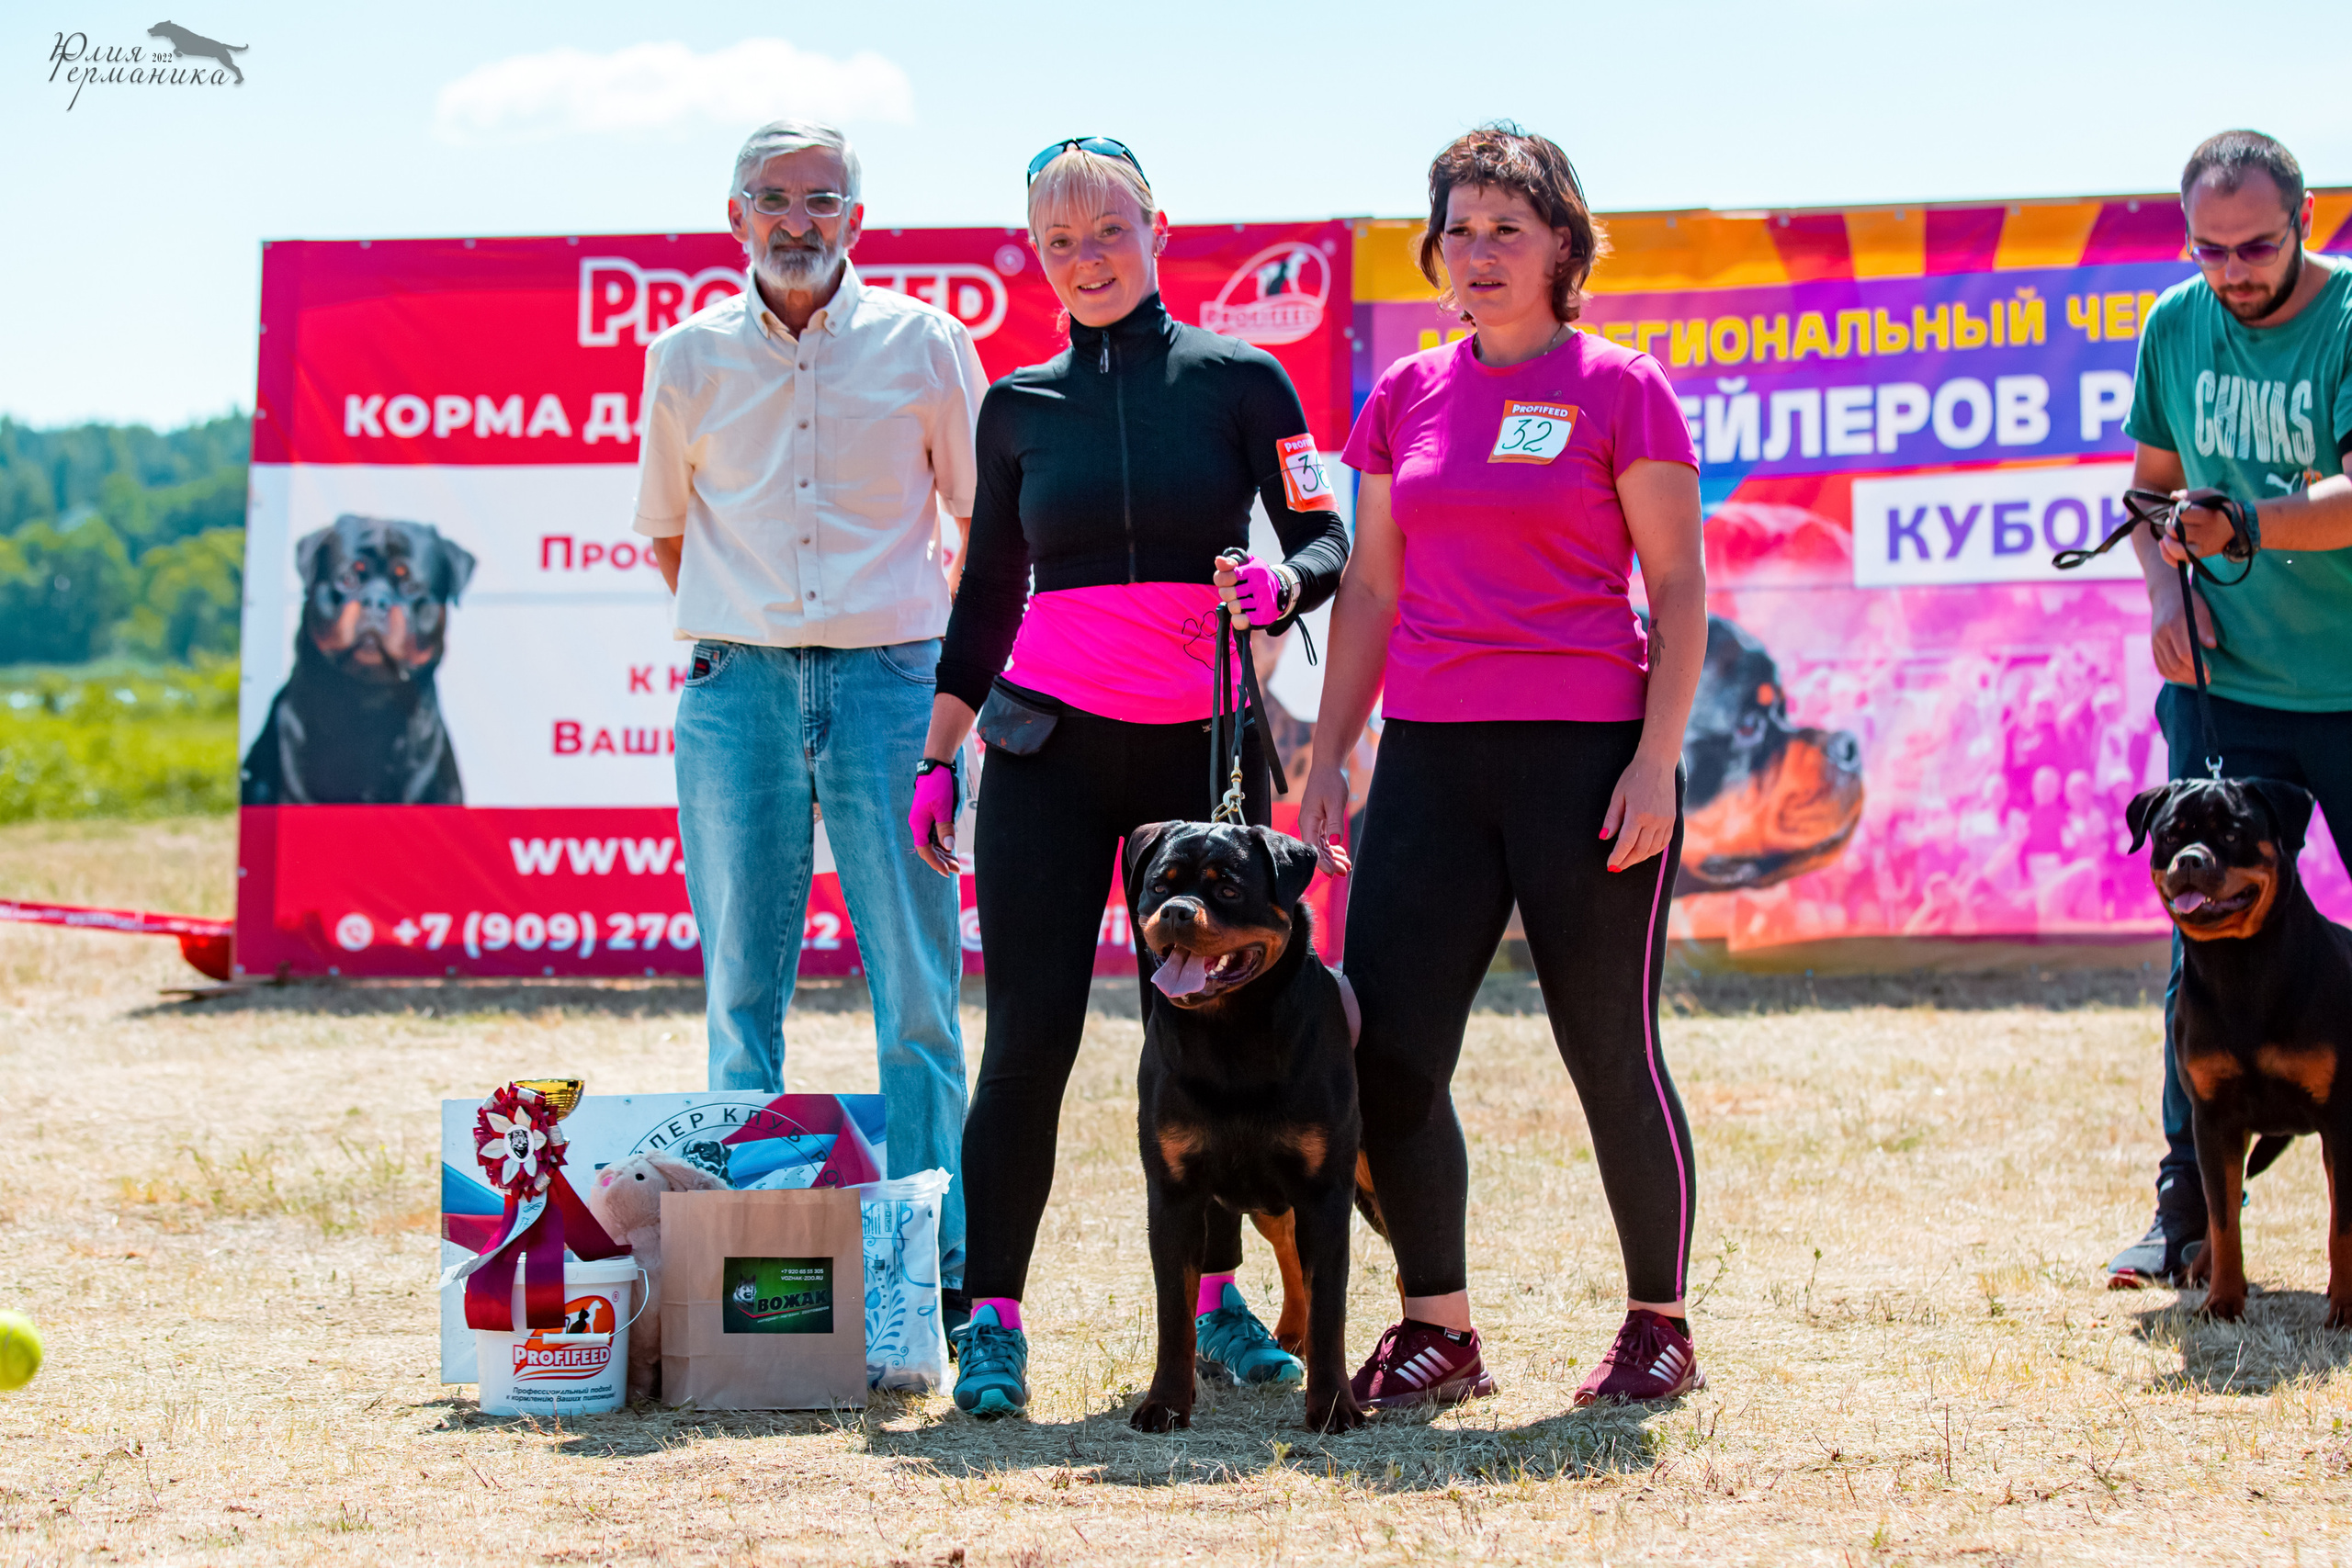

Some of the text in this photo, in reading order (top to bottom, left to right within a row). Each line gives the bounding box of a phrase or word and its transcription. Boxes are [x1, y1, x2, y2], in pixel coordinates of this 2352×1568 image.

[344, 392, 573, 439] КОРМА
[1511, 404, 1568, 418] PROFIFEED
[2195, 369, 2316, 466] CHIVAS
[1501, 419, 1552, 453] 32
[392, 911, 454, 951] +7
[462, 909, 596, 960] (909)
[723, 1108, 803, 1144] КЛУБ
[757, 1289, 827, 1314] ВОЖАК
[514, 1344, 611, 1367] PROFIFEED
[590, 1384, 613, 1393] подход
